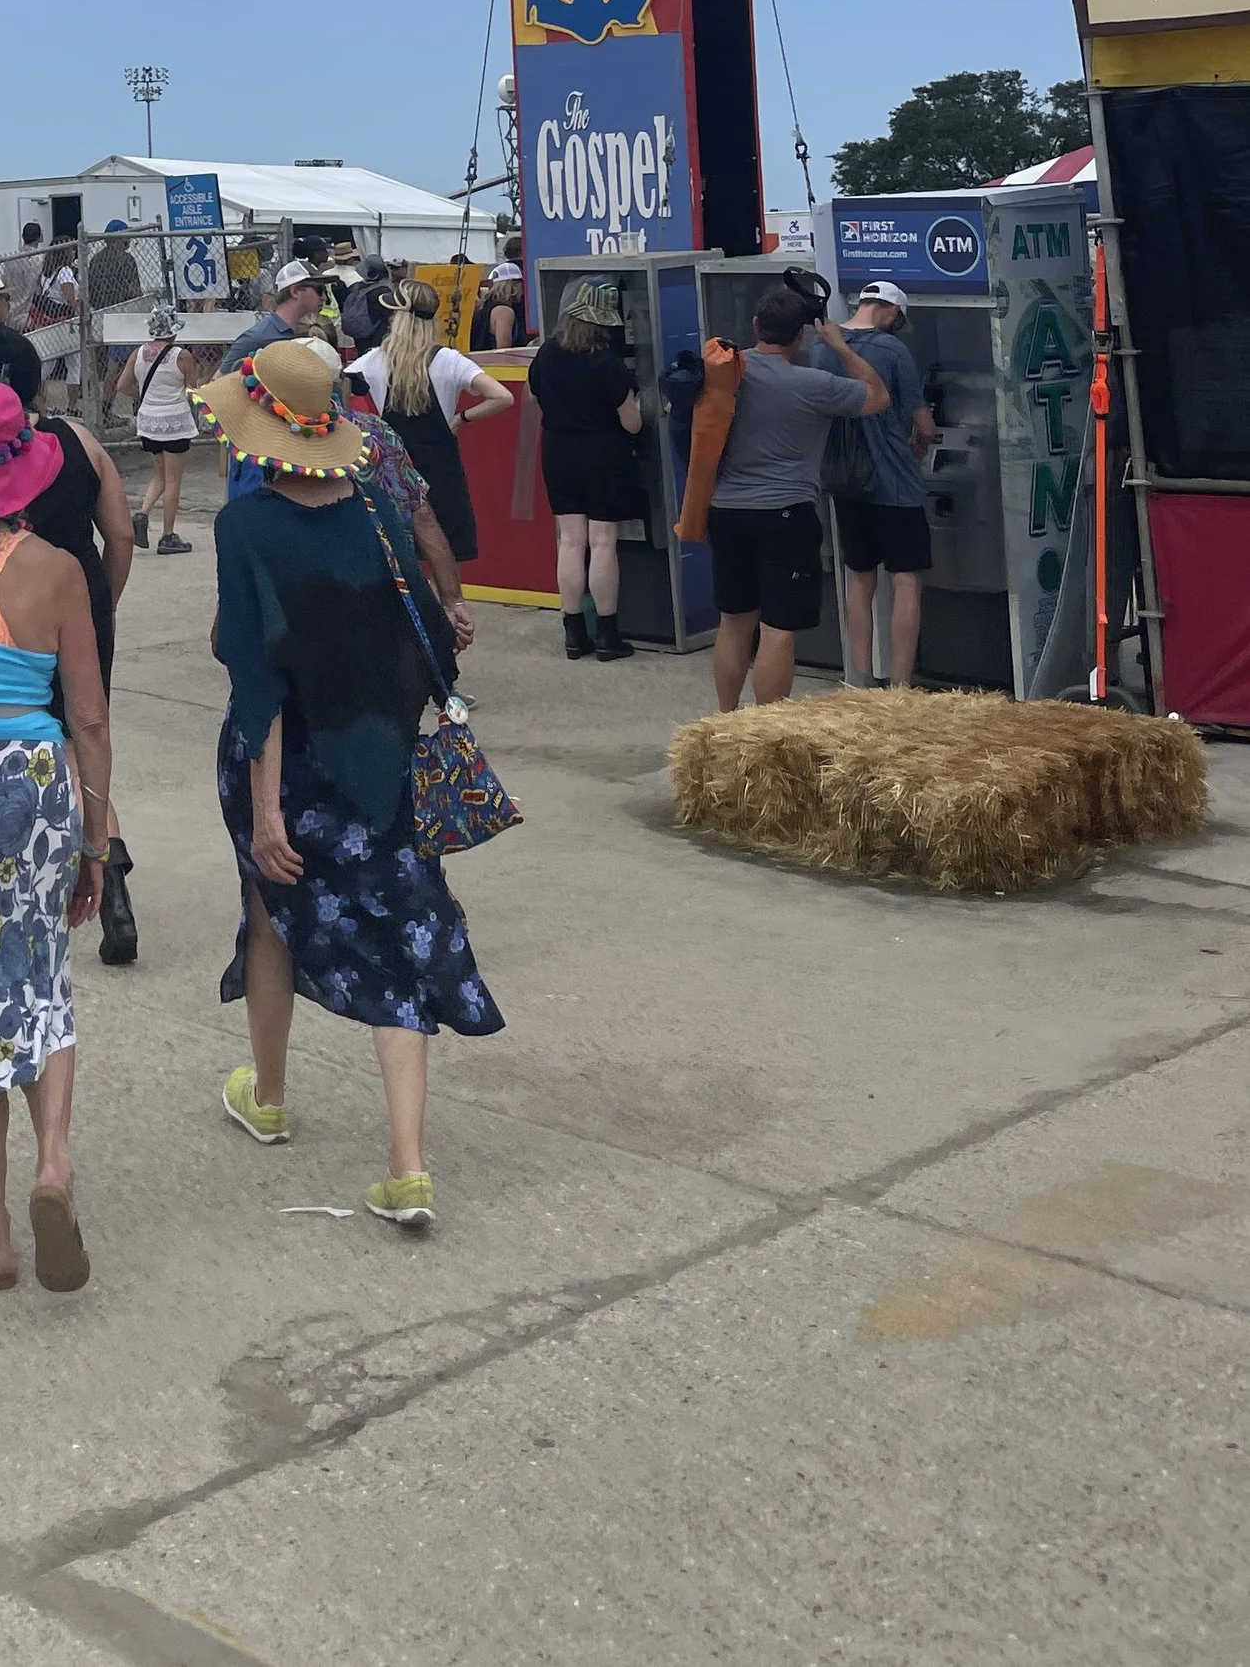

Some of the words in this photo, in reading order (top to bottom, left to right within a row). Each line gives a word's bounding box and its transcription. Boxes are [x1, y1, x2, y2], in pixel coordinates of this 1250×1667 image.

[563, 90, 590, 131] The
[536, 115, 672, 234] Gospel
[170, 192, 214, 205] ACCESSIBLE
[182, 204, 203, 215] AISLE
[174, 215, 213, 227] ENTRANCE
[861, 221, 895, 231] FIRST
[862, 232, 918, 243] HORIZON
[1012, 222, 1070, 260] ATM
[933, 236, 973, 253] ATM
[842, 249, 908, 258] firsthorizon.com
